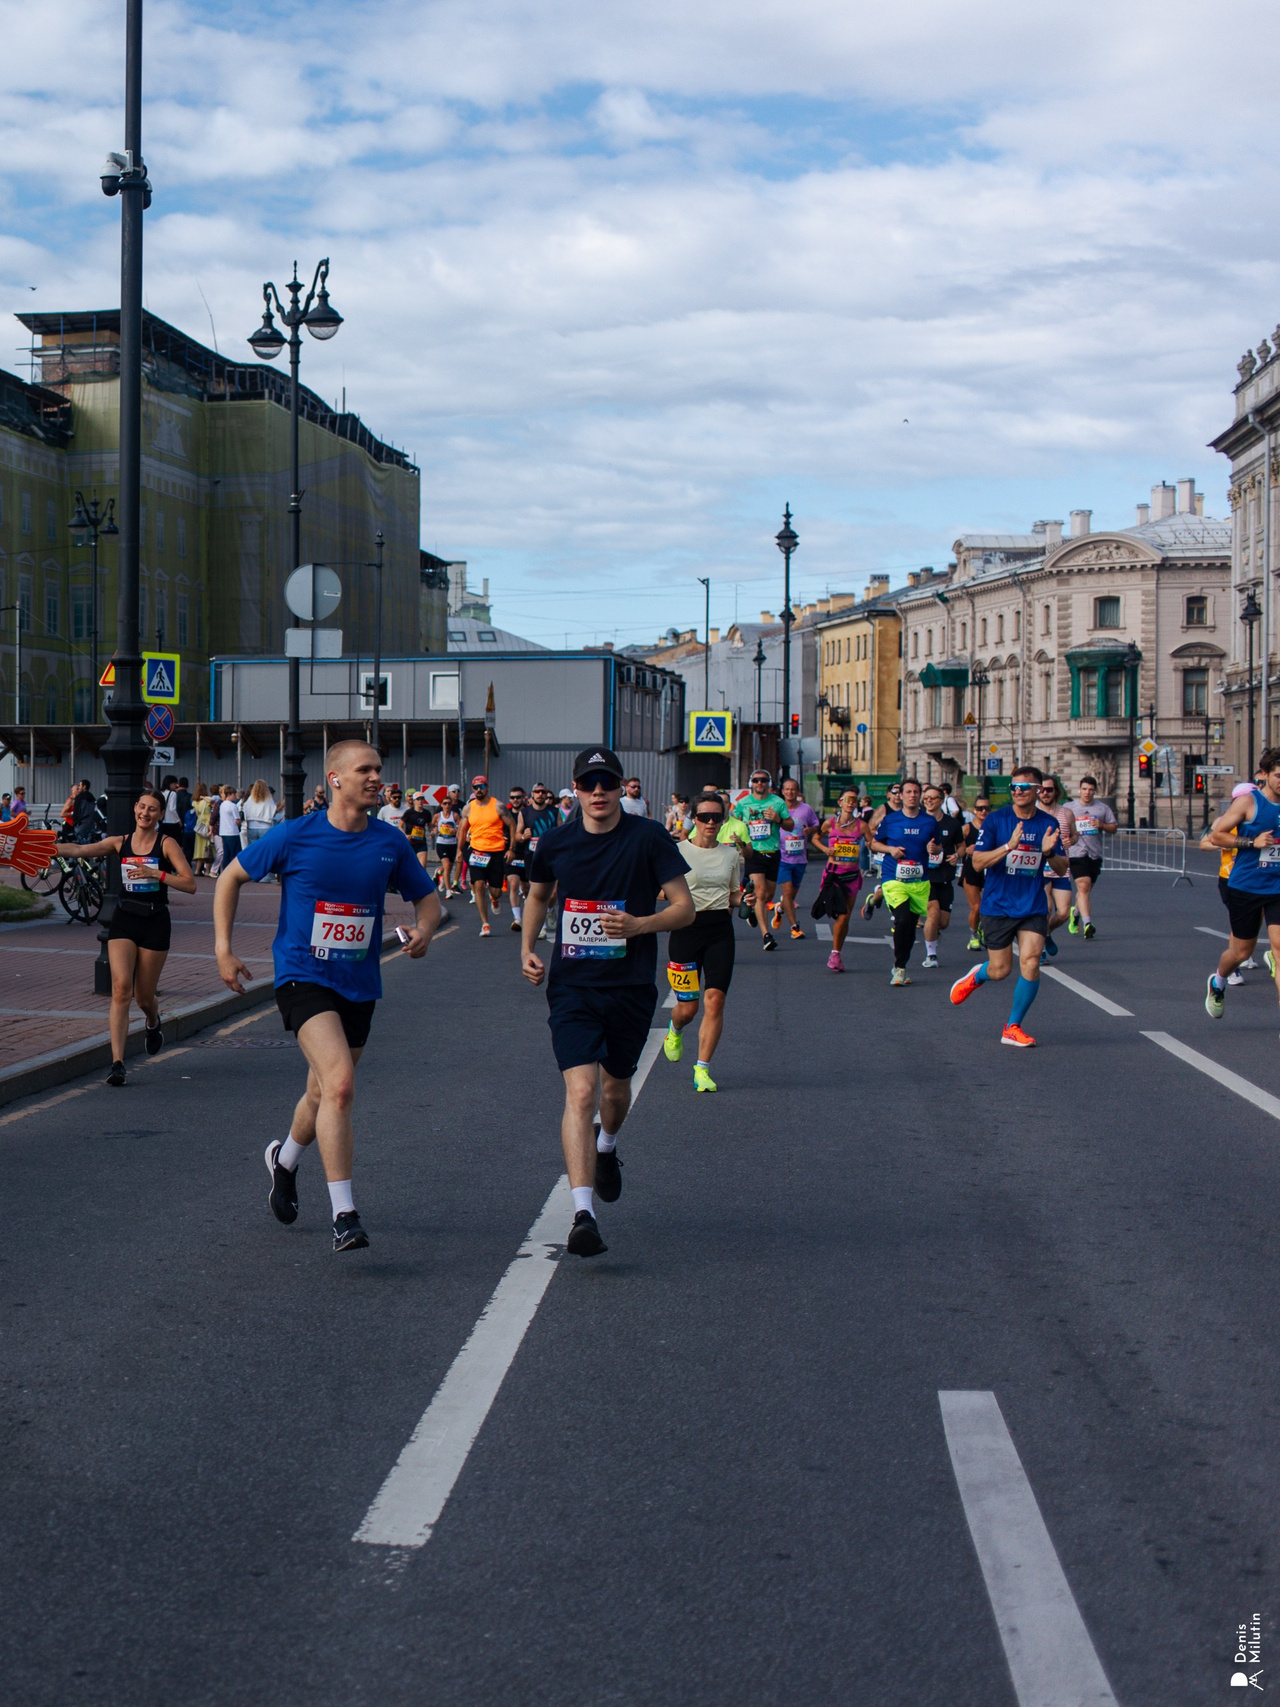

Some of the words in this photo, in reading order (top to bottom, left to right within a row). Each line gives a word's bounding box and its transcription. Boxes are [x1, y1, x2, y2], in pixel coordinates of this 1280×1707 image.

[1, 836, 18, 860] DDX
[1012, 854, 1037, 865] 7133
[322, 922, 365, 942] 7836
[318, 948, 326, 957] D
[568, 946, 575, 955] C
[672, 973, 690, 985] 724
